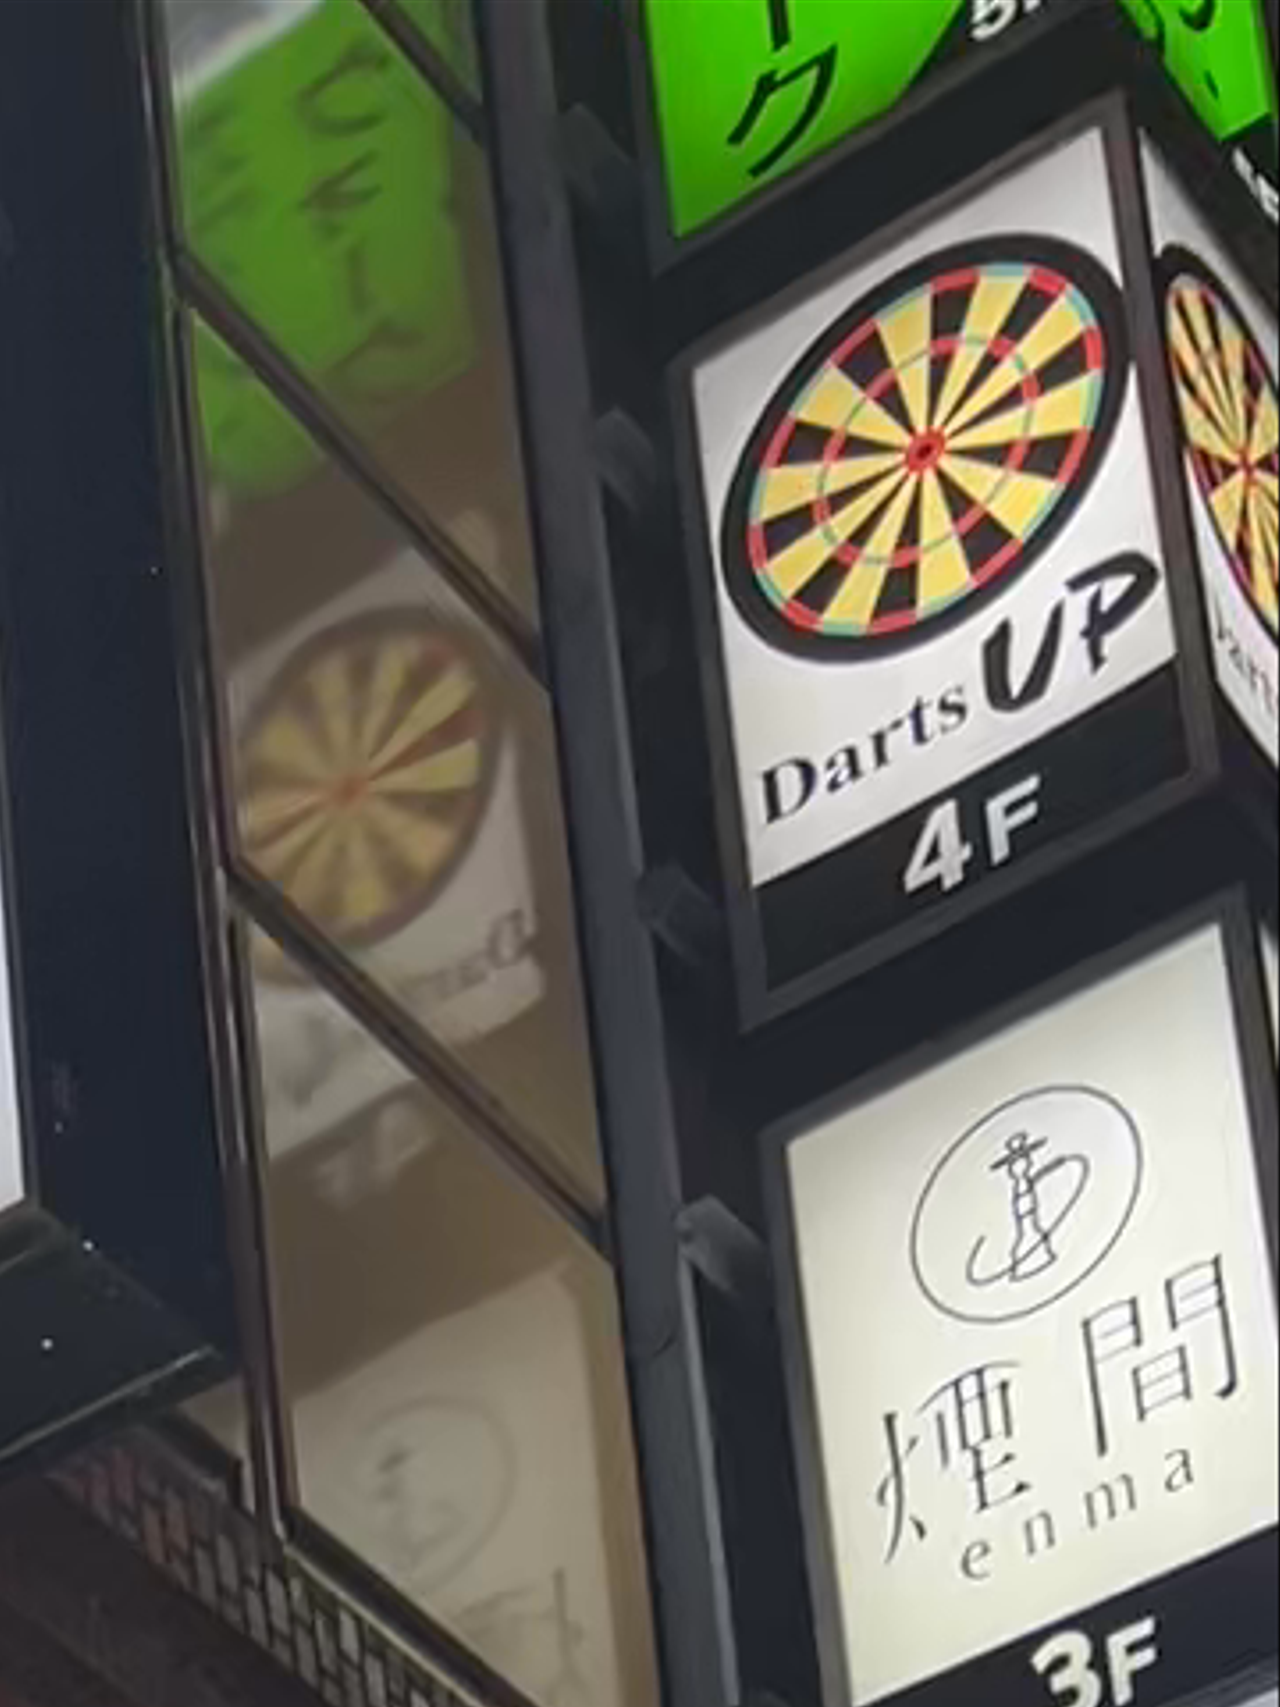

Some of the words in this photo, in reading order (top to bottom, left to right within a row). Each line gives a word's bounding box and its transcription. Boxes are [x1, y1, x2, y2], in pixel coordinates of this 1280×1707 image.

[760, 686, 969, 825] Darts
[981, 551, 1161, 714] UP
[902, 773, 1042, 894] 4F
[876, 1253, 1239, 1565] 煙間
[958, 1446, 1197, 1582] enma
